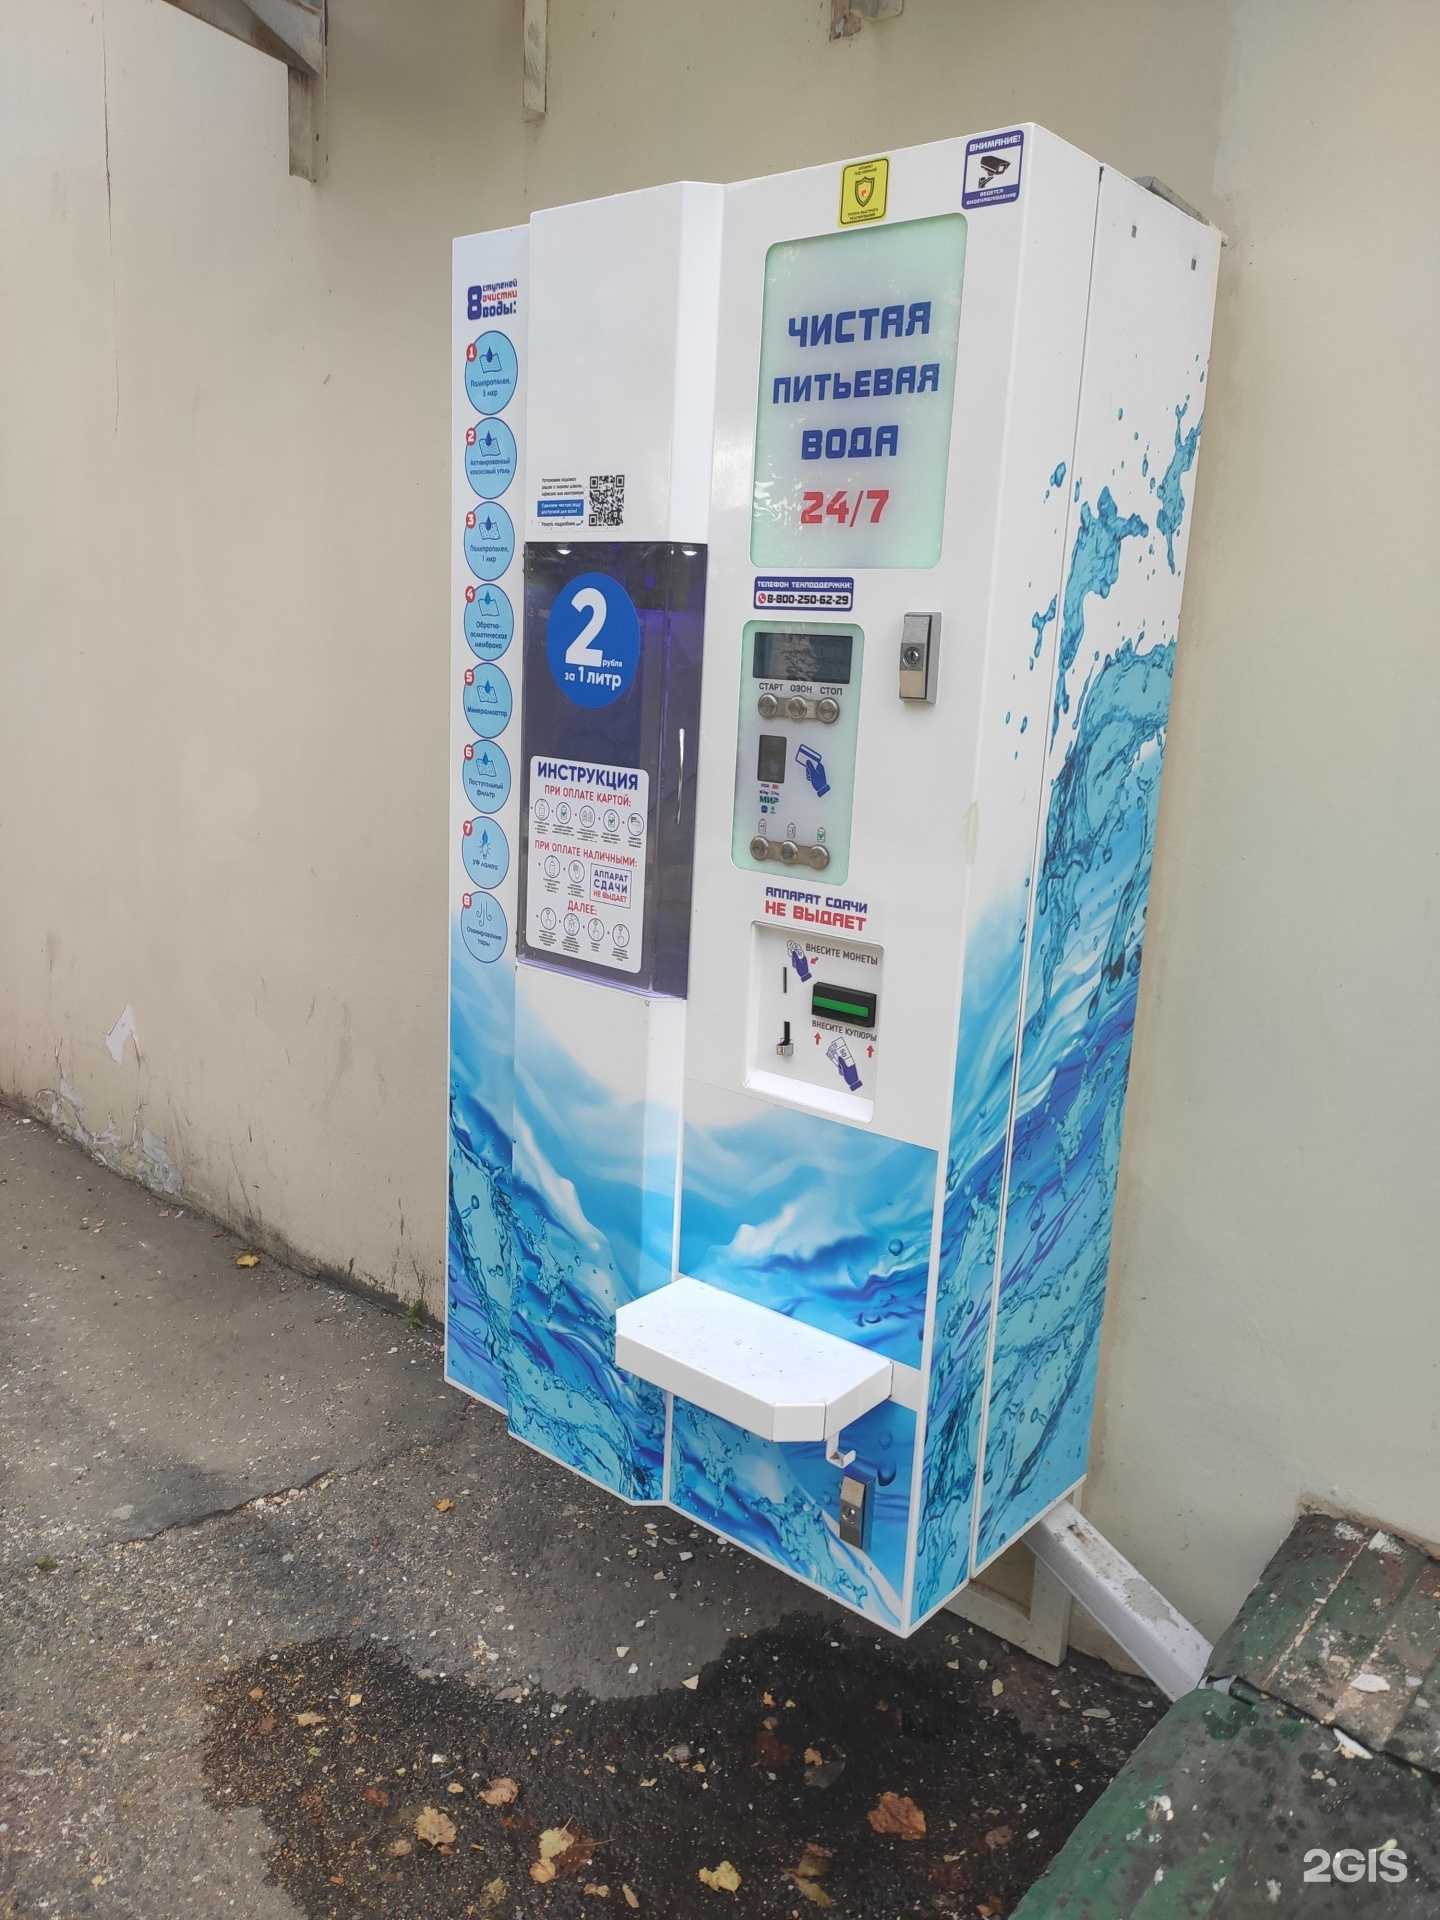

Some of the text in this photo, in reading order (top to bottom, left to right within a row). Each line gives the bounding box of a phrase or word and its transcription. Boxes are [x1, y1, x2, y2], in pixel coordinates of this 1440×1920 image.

[969, 134, 1021, 152] ВНИМАНИЕ!
[483, 290, 518, 302] очистки
[483, 300, 517, 318] воды:
[788, 301, 932, 347] ЧИСТАЯ
[772, 363, 940, 404] ПИТЬЕВАЯ
[801, 425, 899, 460] ВОДА
[800, 489, 890, 528] 24/7
[767, 594, 849, 605] 8-800-250-62-29
[566, 587, 623, 668] 2 рубля
[564, 666, 622, 691] за 1 литр
[758, 682, 784, 692] СТАРТ
[790, 684, 813, 694] ОЗОН
[820, 687, 843, 696] СТОП
[537, 761, 639, 790] ИНСТРУКЦИЯ
[544, 784, 632, 807] ПРИ ОПЛАТЕ КАРТОЙ:
[535, 839, 638, 867] ПРИ ОПЛАТЕ НАЛИЧНЫМИ:
[593, 879, 627, 894] СДАЧИ
[594, 869, 628, 882] АППАРАТ
[593, 890, 601, 898] НЕ
[602, 891, 627, 902] ВЫДАЕТ
[766, 886, 868, 913] АППАРАТ СДАЧИ
[765, 900, 867, 931] НЕ ВЫДАЕТ
[805, 943, 878, 966] ВНЕСИТЕ МОНЕТЫ
[812, 1020, 878, 1042] ВНЕСИТЕ КУПЮРЫ
